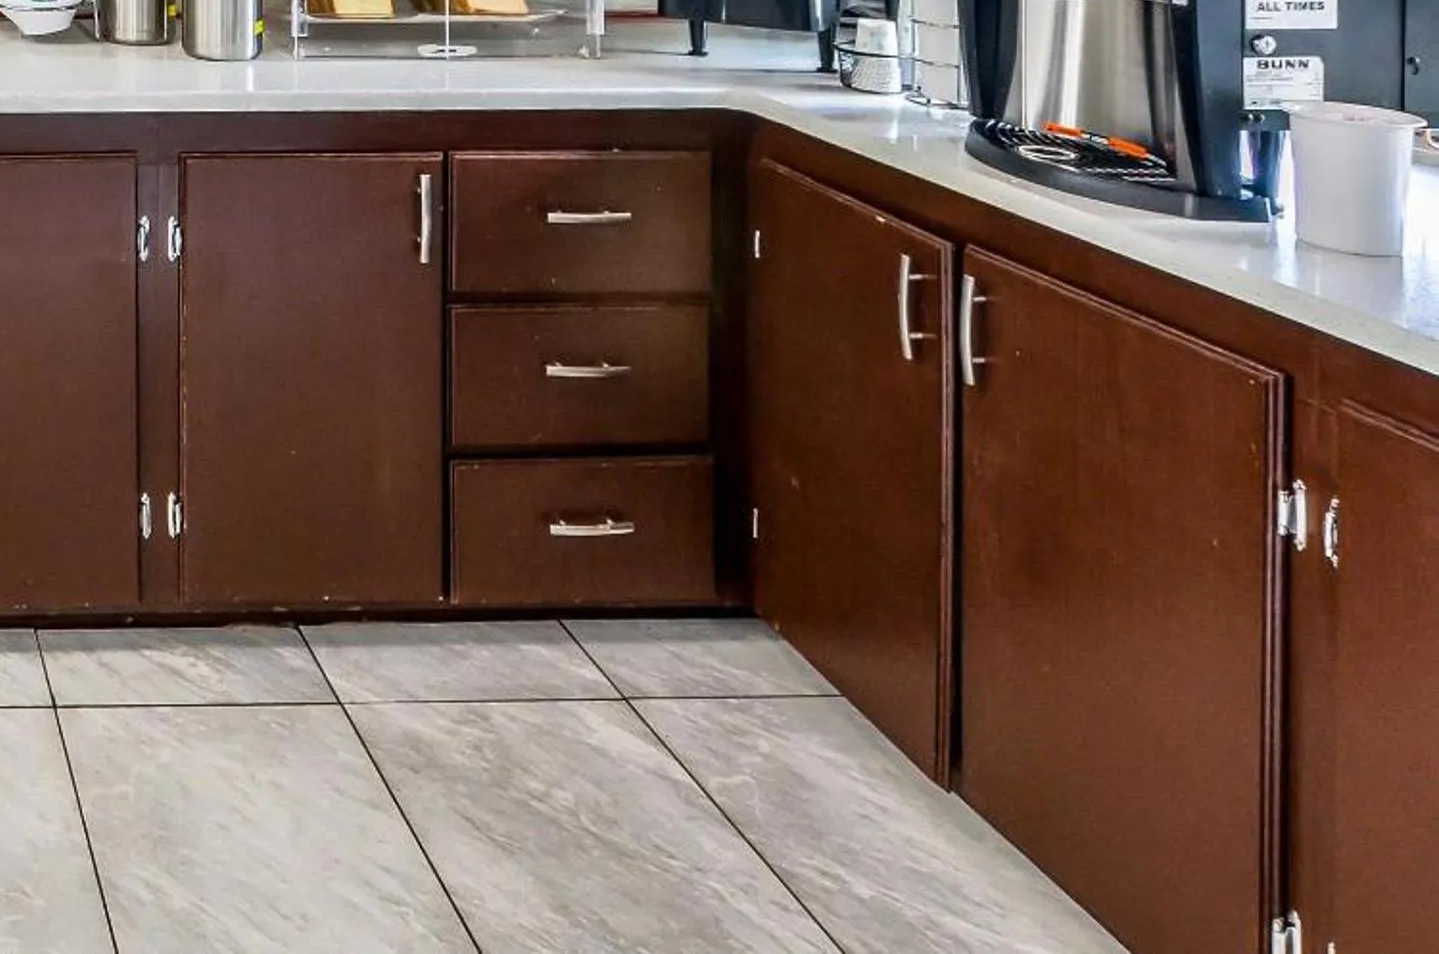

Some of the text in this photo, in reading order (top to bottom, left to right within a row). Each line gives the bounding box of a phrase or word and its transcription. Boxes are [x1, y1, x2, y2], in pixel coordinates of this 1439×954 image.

[1256, 1, 1325, 12] ALL TIMES
[1257, 58, 1311, 70] BUNN
